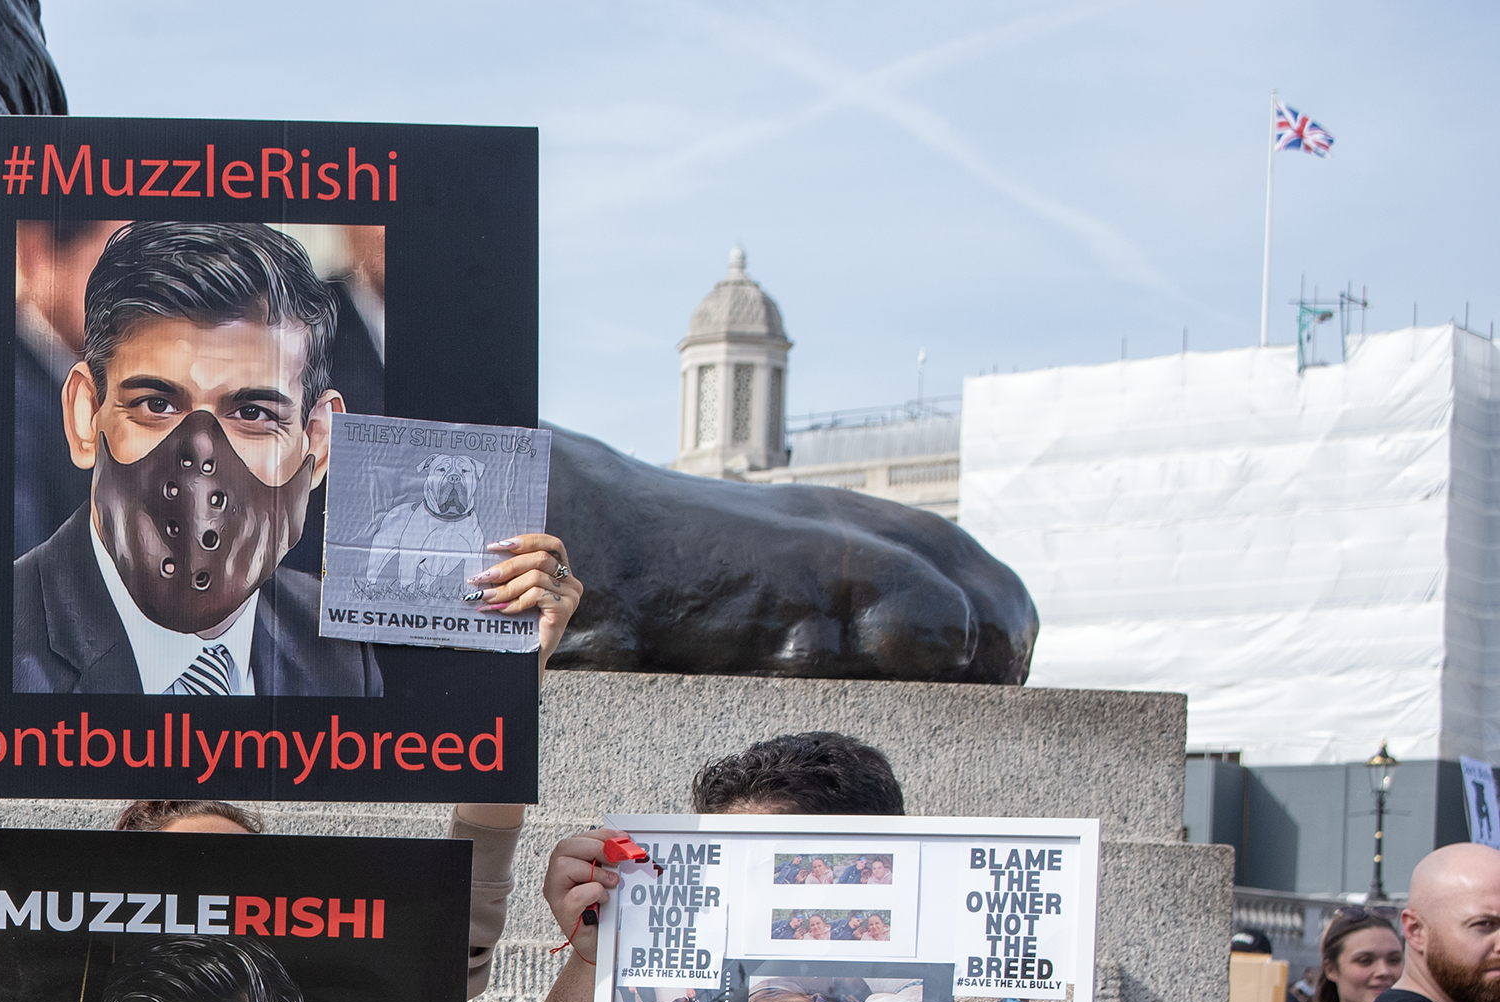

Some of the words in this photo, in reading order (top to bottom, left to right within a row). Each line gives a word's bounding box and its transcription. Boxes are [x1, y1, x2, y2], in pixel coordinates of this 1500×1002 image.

[2, 143, 398, 202] #MuzzleRishi
[344, 422, 406, 445] THEY
[409, 428, 447, 448] SIT
[450, 431, 497, 452] FOR
[501, 435, 537, 458] US,
[328, 608, 359, 624] WE
[362, 611, 428, 629] STAND
[431, 616, 469, 632] FOR
[474, 619, 534, 635] THEM!
[635, 843, 721, 865] BLAME
[970, 848, 1062, 871] BLAME
[653, 864, 701, 885] THE
[990, 870, 1040, 892] THE
[630, 884, 720, 907] OWNER
[966, 891, 1062, 915] OWNER
[648, 906, 699, 927] NOT
[985, 913, 1040, 936] NOT
[649, 927, 696, 948] THE
[986, 935, 1037, 958] THE
[630, 947, 711, 969] BREED
[967, 956, 1053, 980] BREED
[621, 968, 653, 978] #SAVE
[656, 969, 673, 978] THE
[675, 970, 687, 978] XL
[689, 970, 719, 979] BULLY
[957, 978, 991, 987] #SAVE
[994, 979, 1013, 988] THE
[1015, 980, 1027, 989] XL
[1029, 981, 1062, 990] BULLY
